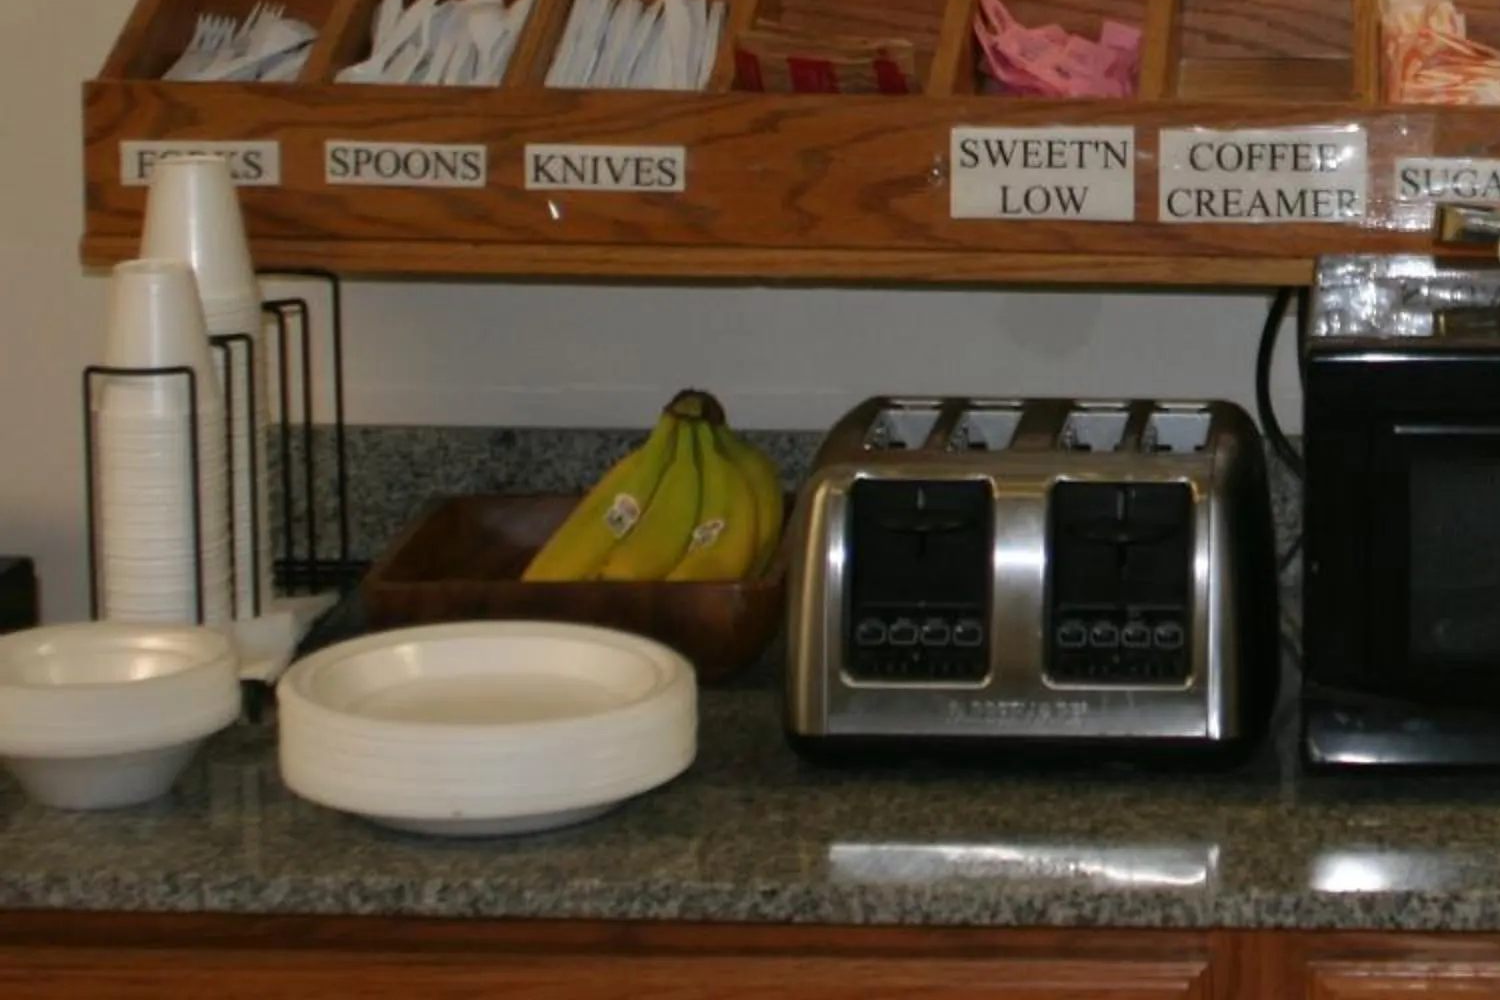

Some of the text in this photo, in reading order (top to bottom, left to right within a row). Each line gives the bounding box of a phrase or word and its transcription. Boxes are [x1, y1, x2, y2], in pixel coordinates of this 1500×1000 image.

[329, 146, 482, 182] SPOONS
[959, 137, 1128, 170] SWEET'N
[1188, 140, 1339, 174] COFFEE
[531, 153, 678, 188] KNIVES
[1000, 184, 1087, 216] LOW
[1165, 188, 1361, 220] CREAMER
